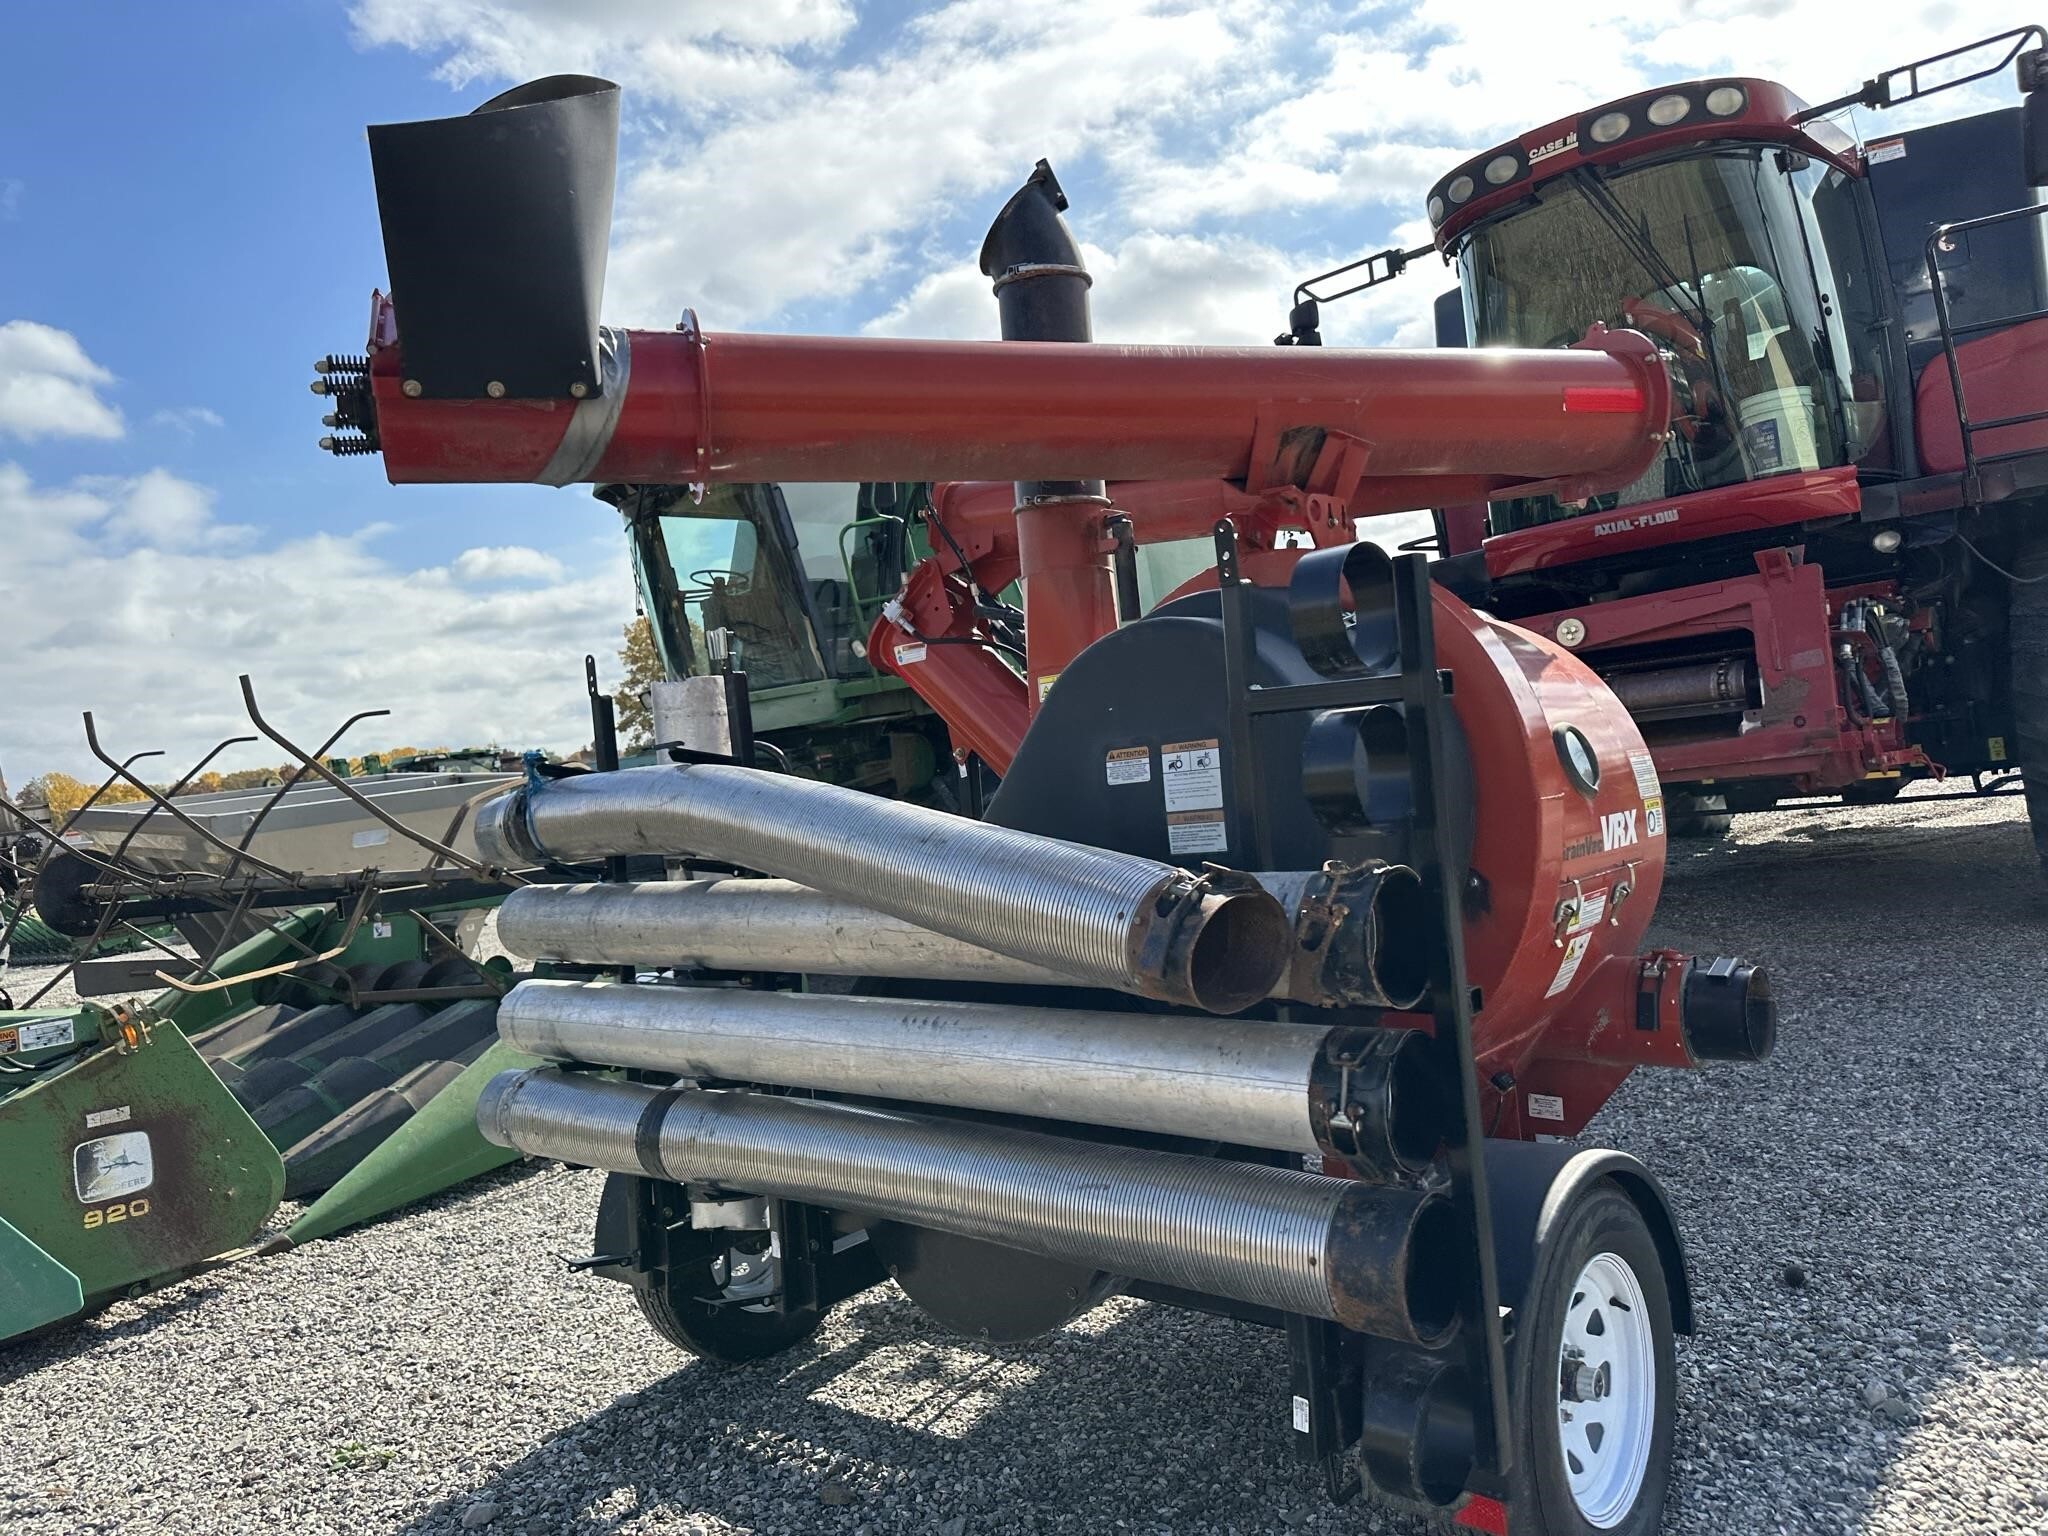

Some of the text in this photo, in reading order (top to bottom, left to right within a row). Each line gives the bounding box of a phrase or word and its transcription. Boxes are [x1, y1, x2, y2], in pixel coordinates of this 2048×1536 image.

[1528, 138, 1564, 159] CASE
[1594, 509, 1680, 537] AXIAL-FLOW
[1115, 749, 1148, 759] ATTENTION
[1178, 741, 1207, 751] WARNING
[1600, 808, 1638, 852] VRX
[82, 1175, 147, 1199] JO DEERE
[83, 1198, 150, 1230] 920
